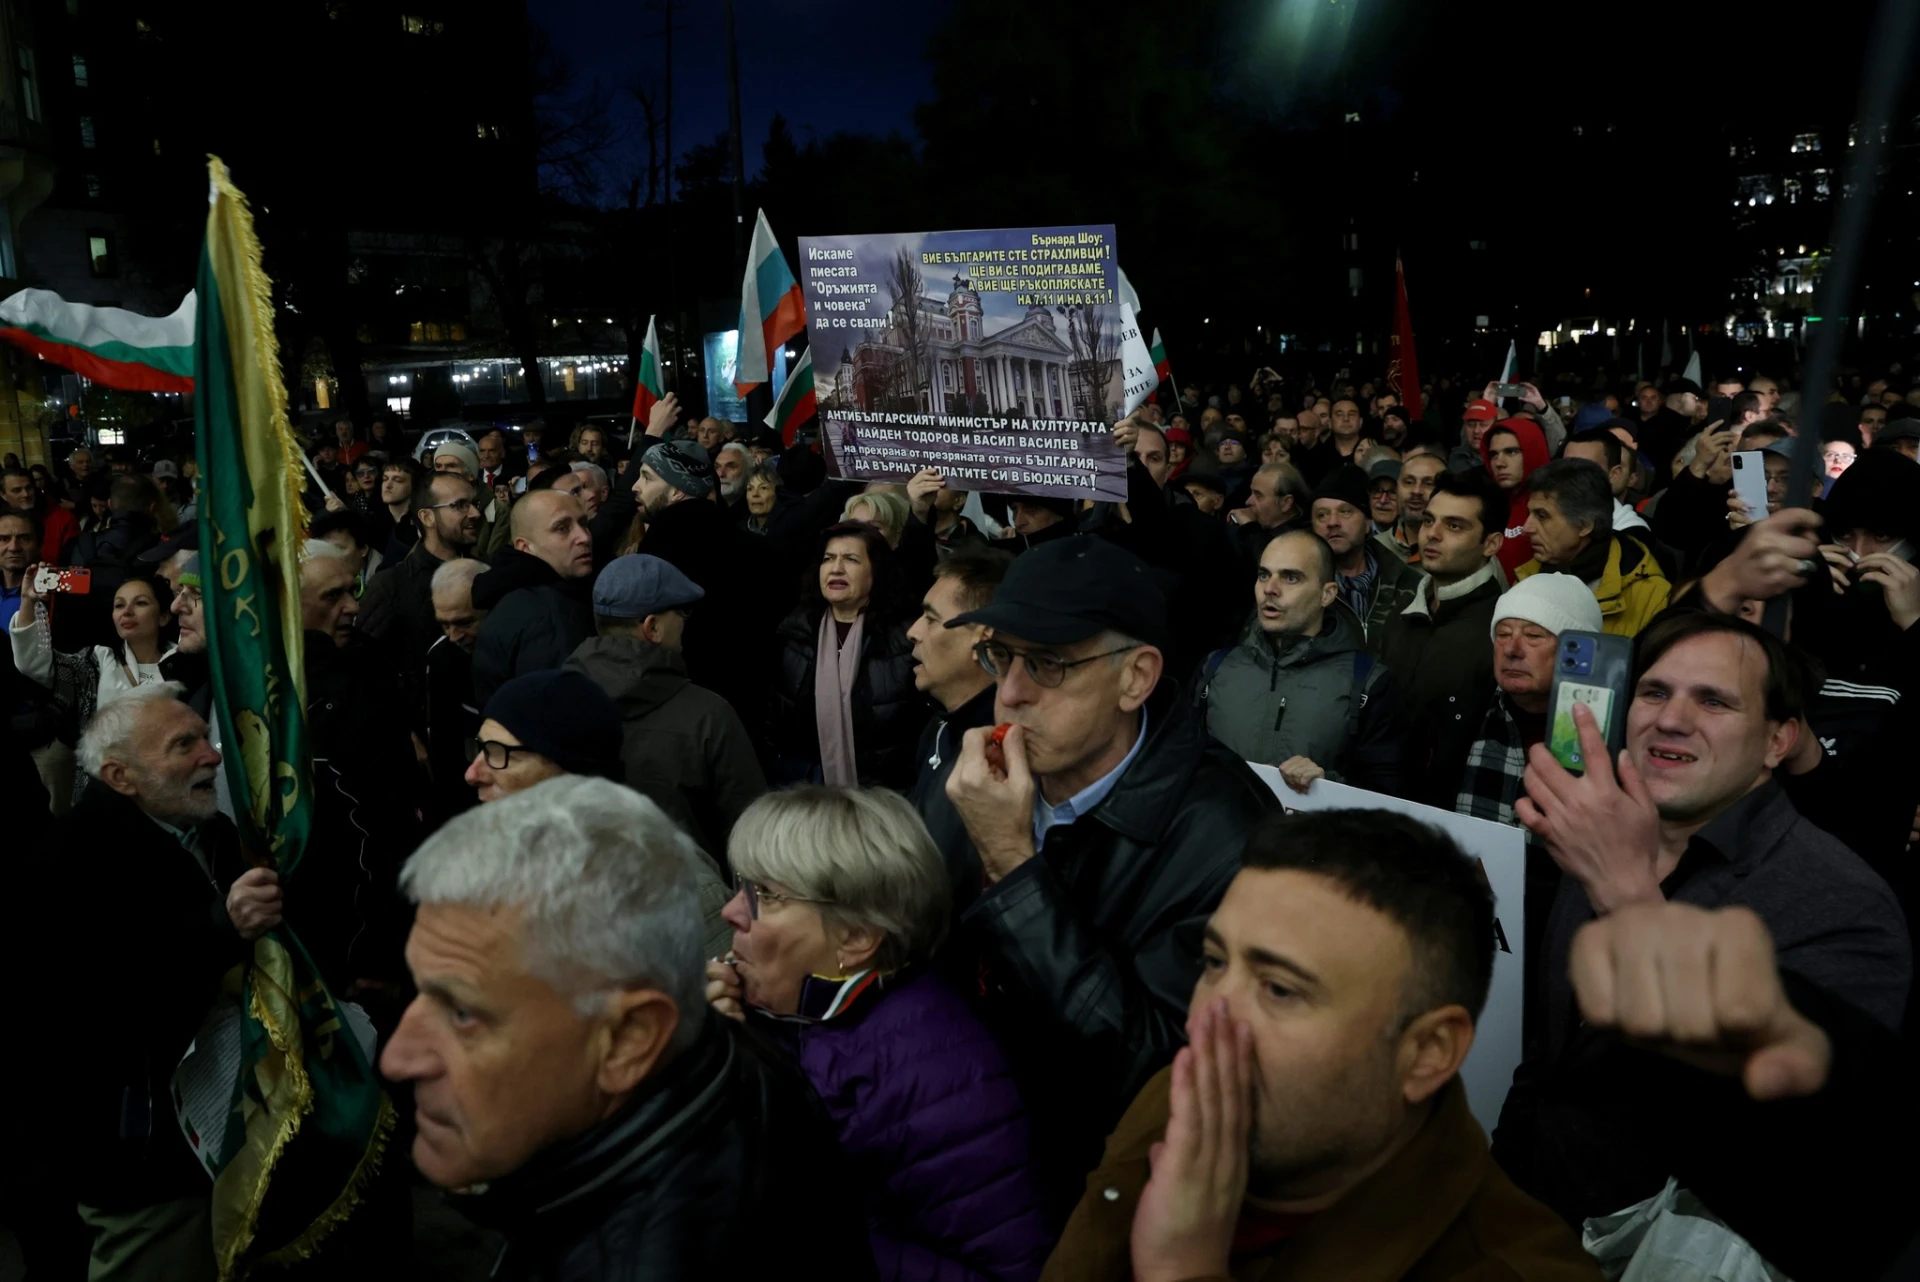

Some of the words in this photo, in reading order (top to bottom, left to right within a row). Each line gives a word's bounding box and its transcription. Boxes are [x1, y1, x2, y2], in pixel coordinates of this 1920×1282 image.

[1031, 234, 1076, 247] Бърнард
[1078, 232, 1103, 246] Шоу:
[808, 247, 853, 261] Искаме
[922, 252, 942, 264] ВИЕ
[944, 250, 1006, 263] БЪЛГАРИТЕ
[1008, 250, 1028, 261] СТЕ
[810, 266, 858, 278] пиесата
[969, 265, 986, 278] ЩЕ
[988, 265, 1003, 276] ВИ
[1005, 265, 1019, 276] СЕ
[1021, 263, 1105, 277] ПОДИГРАВАМЕ,
[968, 280, 975, 291] А
[977, 280, 998, 291] ВИЕ
[1000, 280, 1017, 292] ЩЕ
[1019, 278, 1105, 291] РЪКОПЛЯСКАТЕ
[814, 301, 821, 311] и
[1017, 294, 1032, 305] НА
[1034, 294, 1054, 305] 7.11
[1056, 294, 1064, 305] И
[1067, 294, 1082, 305] НА
[816, 318, 830, 330] да
[832, 318, 847, 328] се
[1120, 328, 1137, 342] ЕВ
[1123, 379, 1153, 398] РИТЕ
[827, 410, 936, 426] АНТИБЪЛГАРСКИЯТ
[939, 415, 1008, 429] МИНИСТЪР
[1011, 418, 1029, 431] НА
[1032, 420, 1107, 434] КУЛТУРАТА
[856, 427, 902, 441] НАЙДЕН
[904, 430, 959, 444] ТОДОРОВ
[961, 433, 970, 445] И
[973, 434, 1015, 447] ВАСИЛ
[1019, 436, 1079, 450] ВАСИЛЕВ
[843, 444, 856, 453] на
[858, 446, 907, 458] прехрана
[909, 449, 920, 458] от
[922, 450, 986, 463] презряната
[988, 454, 1000, 463] от
[1003, 456, 1023, 465] тях
[1025, 454, 1098, 472] БЪЛГАРИЯ,
[855, 459, 870, 471] ДА
[872, 461, 917, 474] ВЪРНАТ
[991, 470, 1008, 481] СИ
[1011, 471, 1020, 482] В
